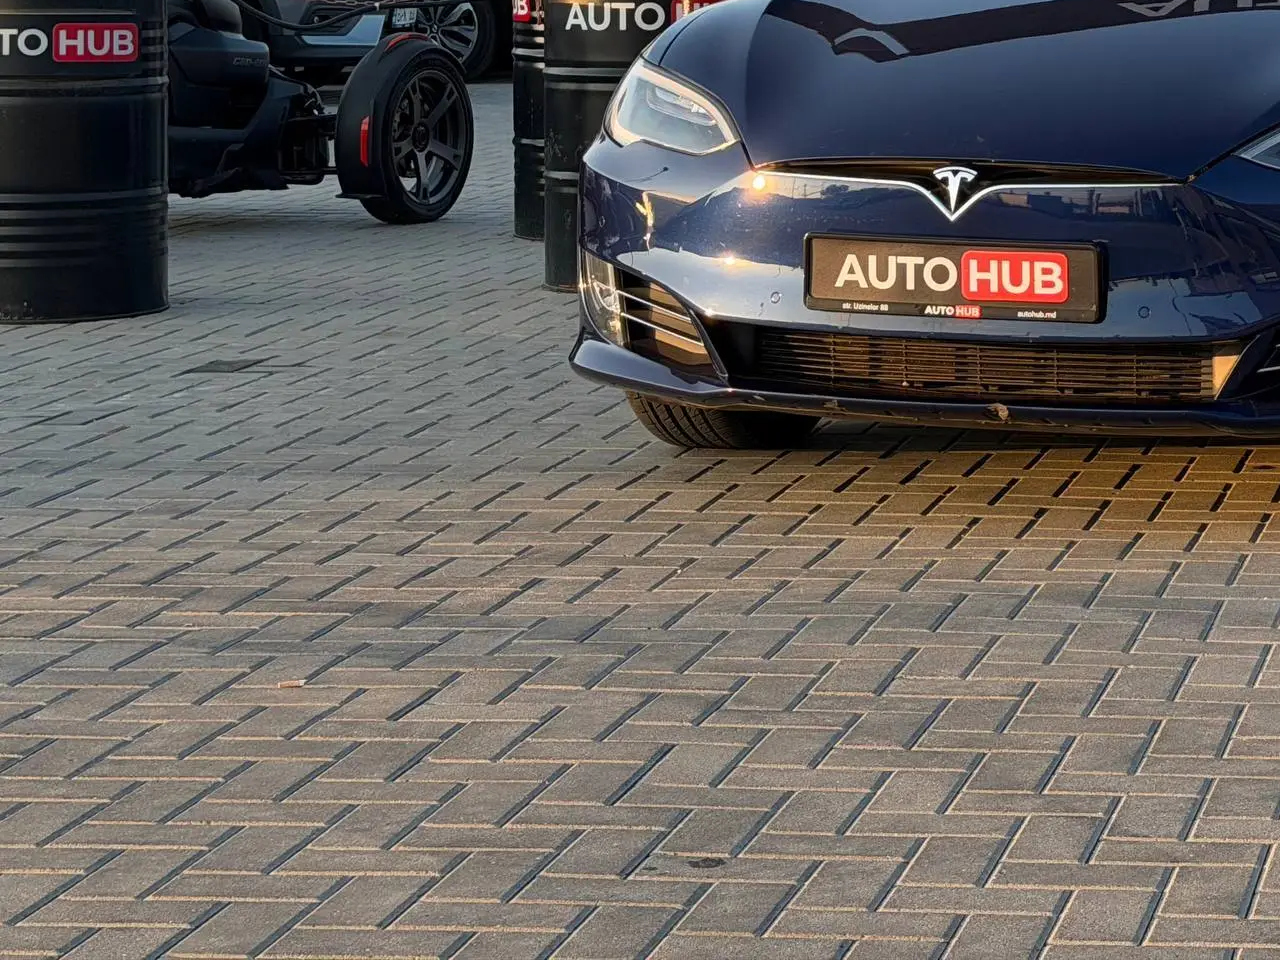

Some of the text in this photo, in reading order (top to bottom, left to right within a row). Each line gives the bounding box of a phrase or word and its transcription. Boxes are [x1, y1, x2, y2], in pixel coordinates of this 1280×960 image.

[564, 1, 666, 31] AUTO
[0, 28, 135, 57] TO HUB
[834, 253, 1064, 295] AUTO HUB
[924, 305, 980, 317] AUTO HUB
[1017, 310, 1057, 319] autohub.md
